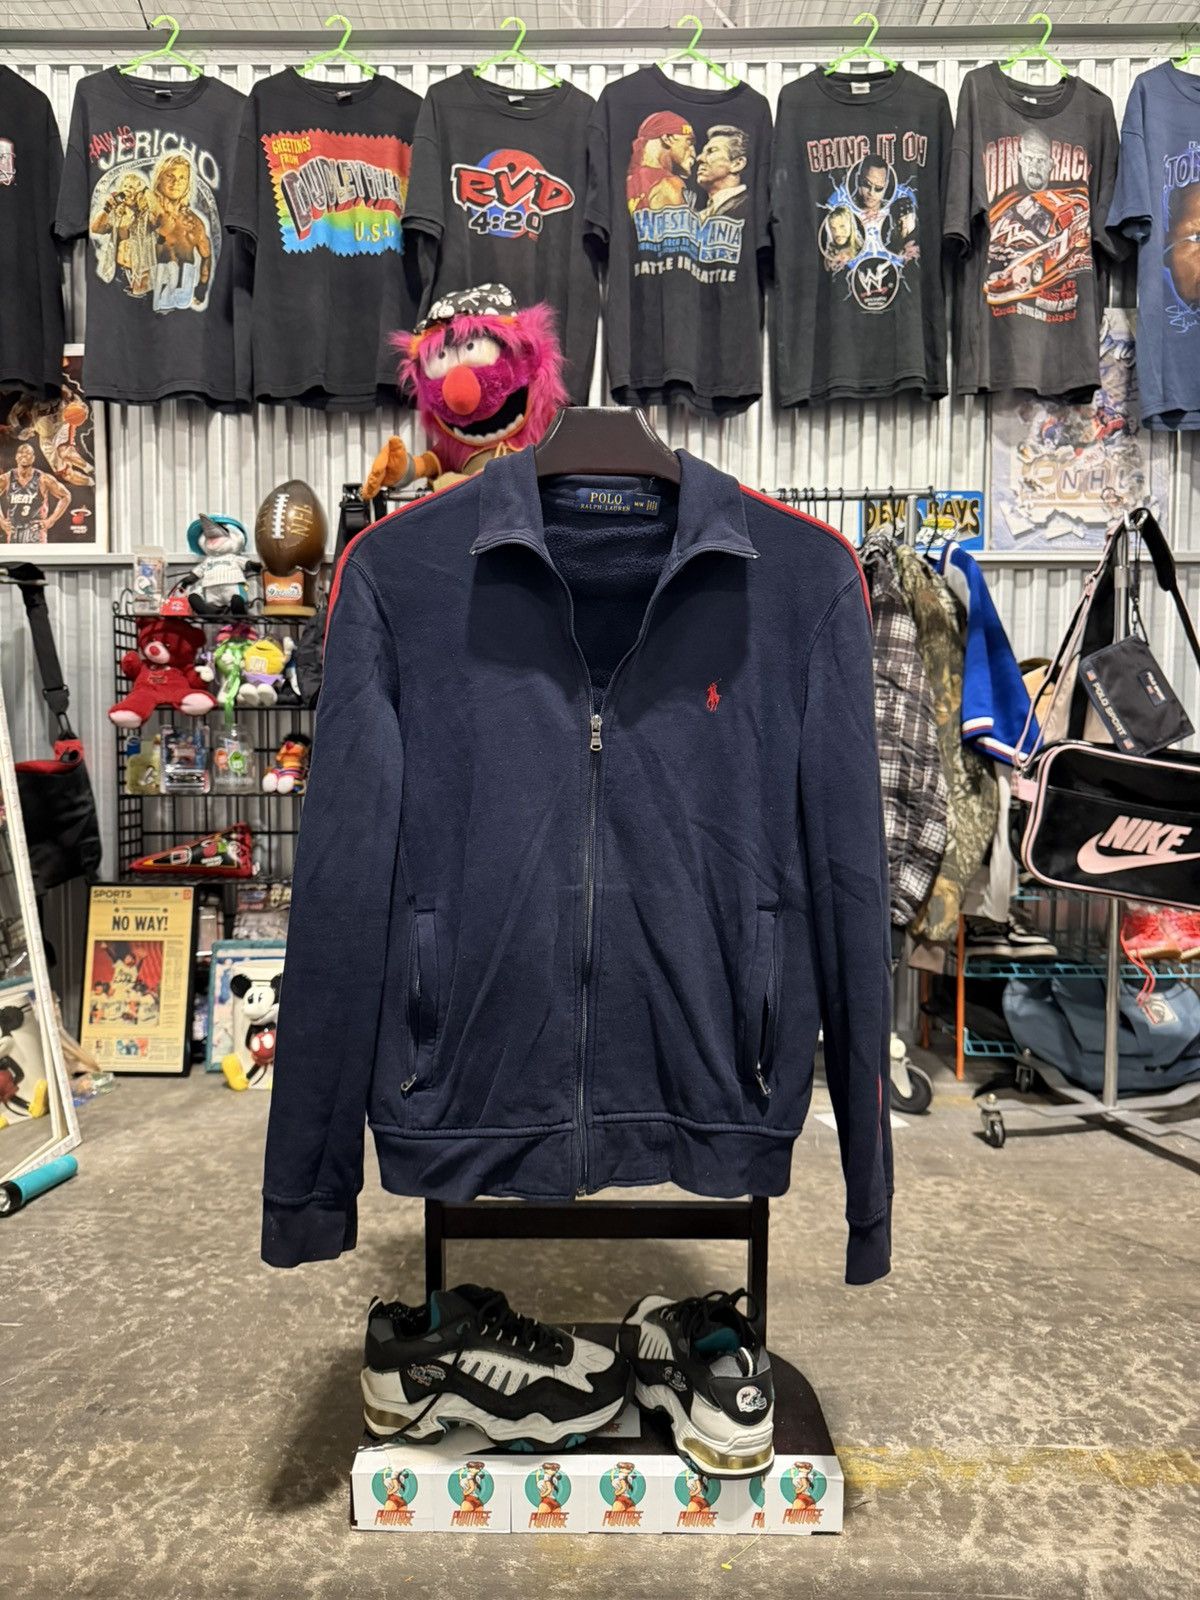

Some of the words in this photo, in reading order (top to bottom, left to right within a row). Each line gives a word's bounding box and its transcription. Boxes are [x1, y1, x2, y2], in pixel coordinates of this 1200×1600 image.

[98, 129, 219, 189] JERICHO
[468, 209, 543, 234] 4:20
[590, 491, 622, 505] POLO
[21, 505, 31, 517] 3
[1092, 681, 1110, 707] POLO
[1104, 706, 1129, 737] SPORT
[1098, 814, 1193, 856] NIKE
[93, 889, 132, 899] SPORTS
[112, 915, 130, 931] NO
[135, 915, 168, 932] WAY!
